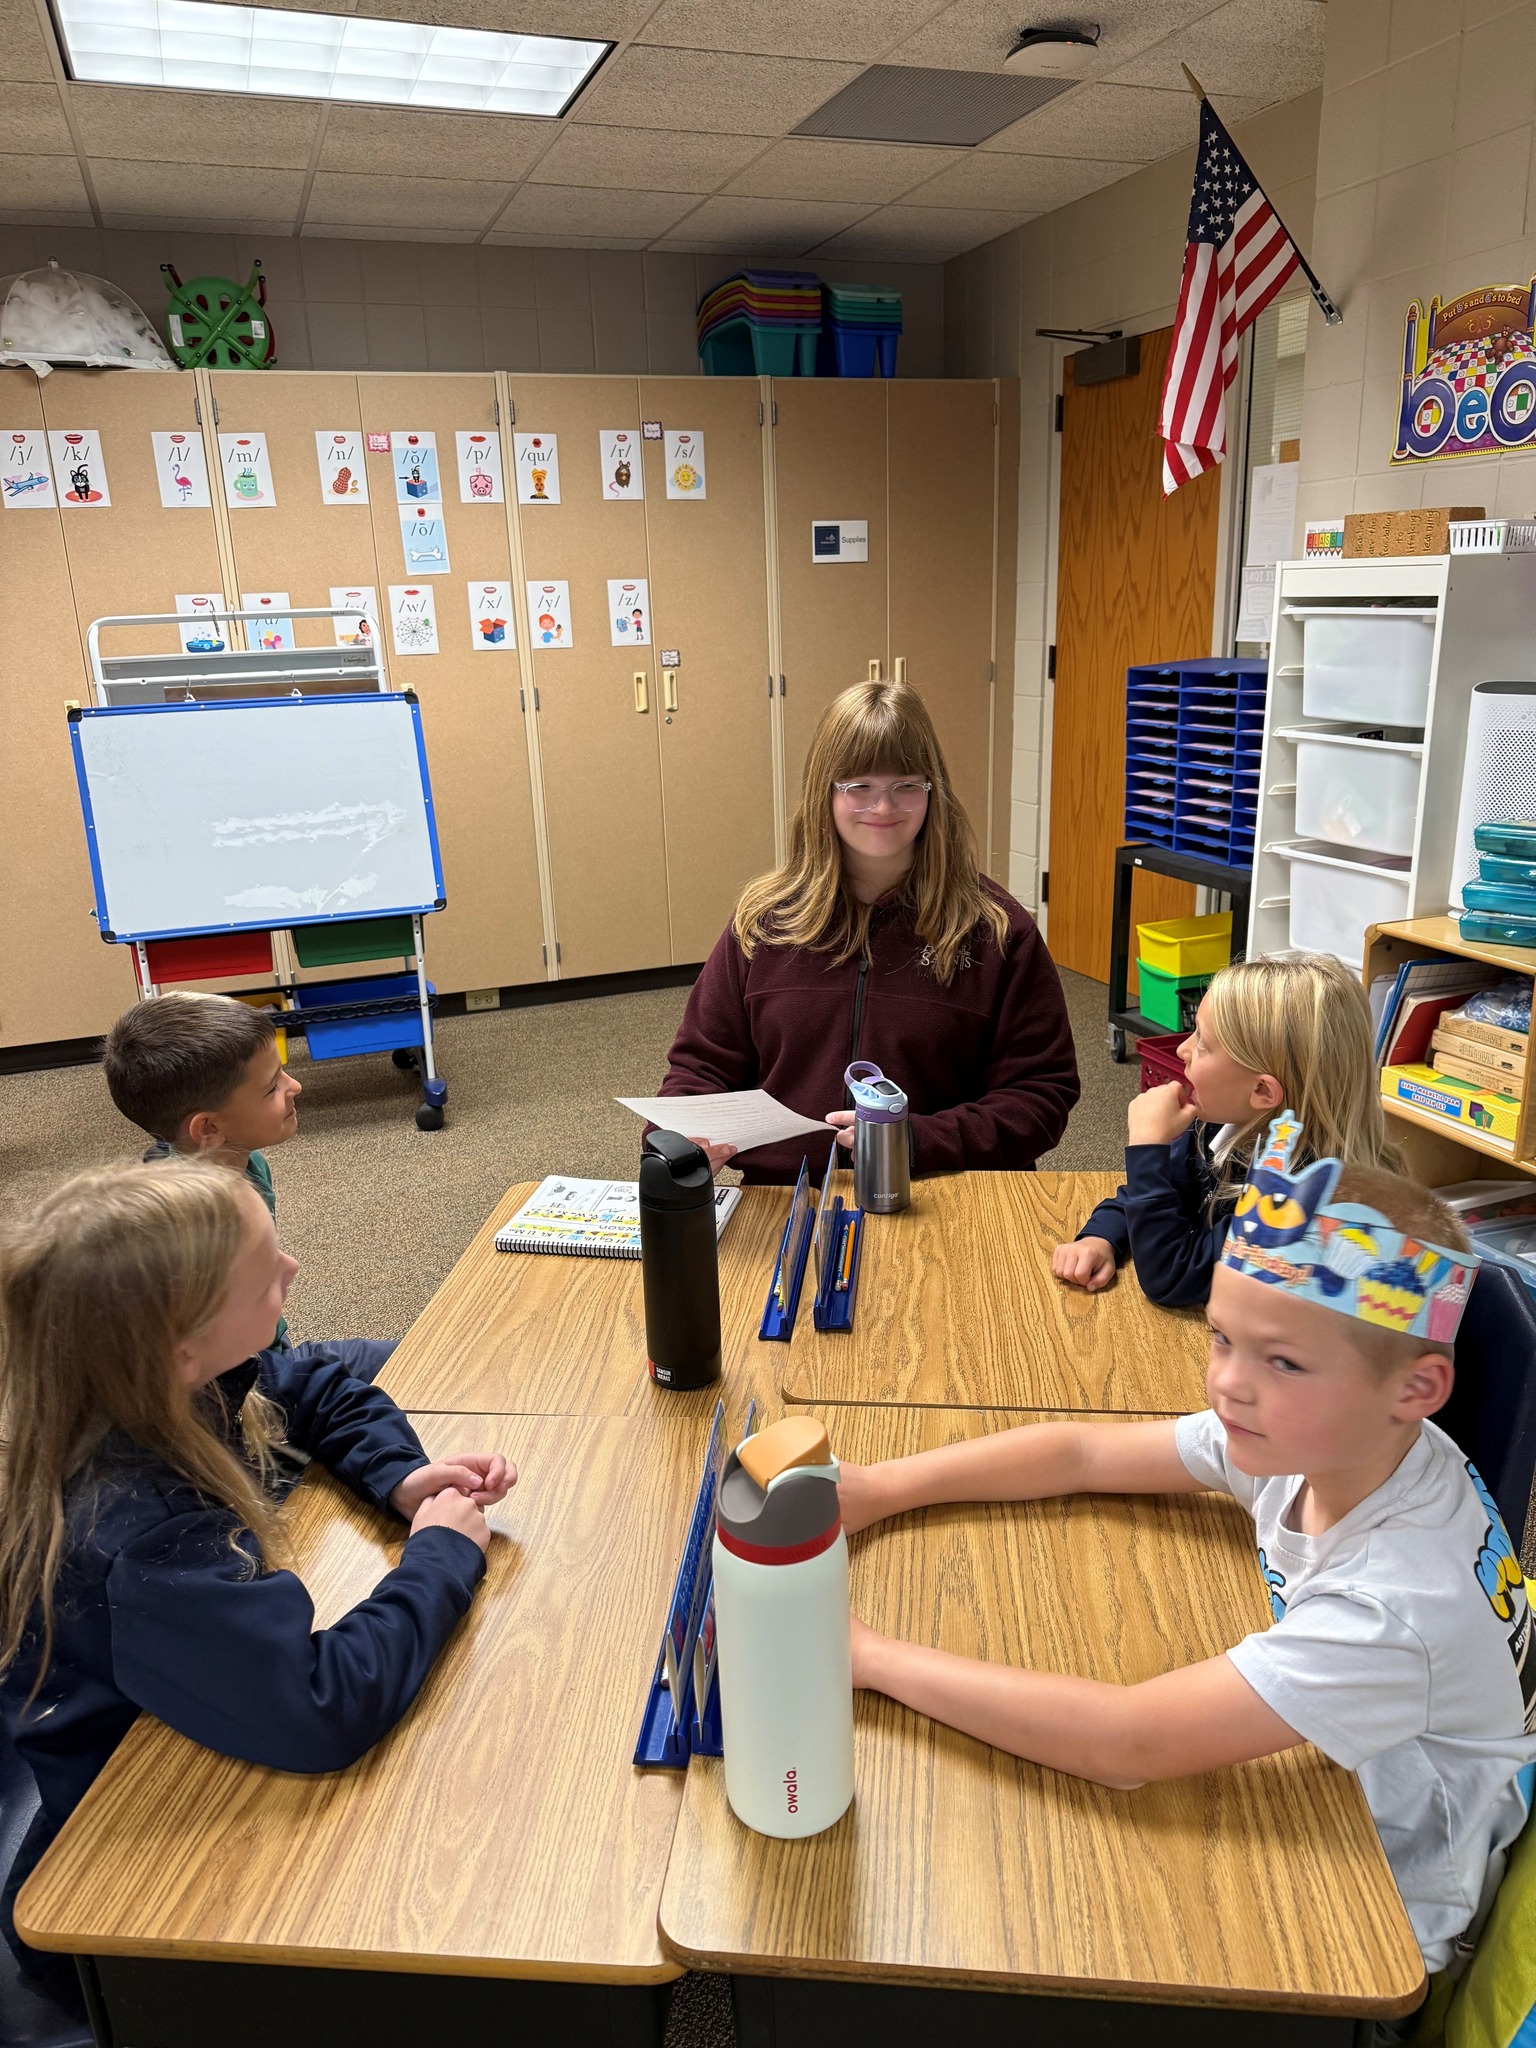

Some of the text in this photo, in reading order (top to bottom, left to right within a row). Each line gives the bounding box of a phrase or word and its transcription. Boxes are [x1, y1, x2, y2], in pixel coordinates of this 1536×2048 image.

[1442, 308, 1457, 322] Put
[1456, 301, 1468, 313] b's
[1470, 294, 1484, 307] and
[1498, 294, 1506, 302] to
[1507, 292, 1522, 305] bed
[10, 445, 33, 466] /j/
[62, 446, 90, 462] /k/
[228, 447, 260, 464] /m/
[328, 446, 354, 462] /n/
[466, 446, 492, 464] /p/
[520, 448, 553, 466] /qu/
[610, 444, 632, 459] /r/
[675, 445, 695, 460] /s/
[1368, 518, 1376, 534] the
[1423, 510, 1440, 552] learning
[841, 536, 866, 544] Supplies
[1395, 532, 1404, 544] to
[1406, 515, 1421, 554] lifelong
[398, 599, 426, 614] /w/
[478, 596, 502, 610] /x/
[538, 594, 561, 614] /y/
[618, 592, 640, 606] /z/
[1401, 1081, 1460, 1108] GIANT MAGNETIC FOAM
[1412, 1092, 1425, 1104] BASE
[1436, 1102, 1446, 1110] SET
[874, 1192, 898, 1200] contigo
[783, 1770, 798, 1814] owala
